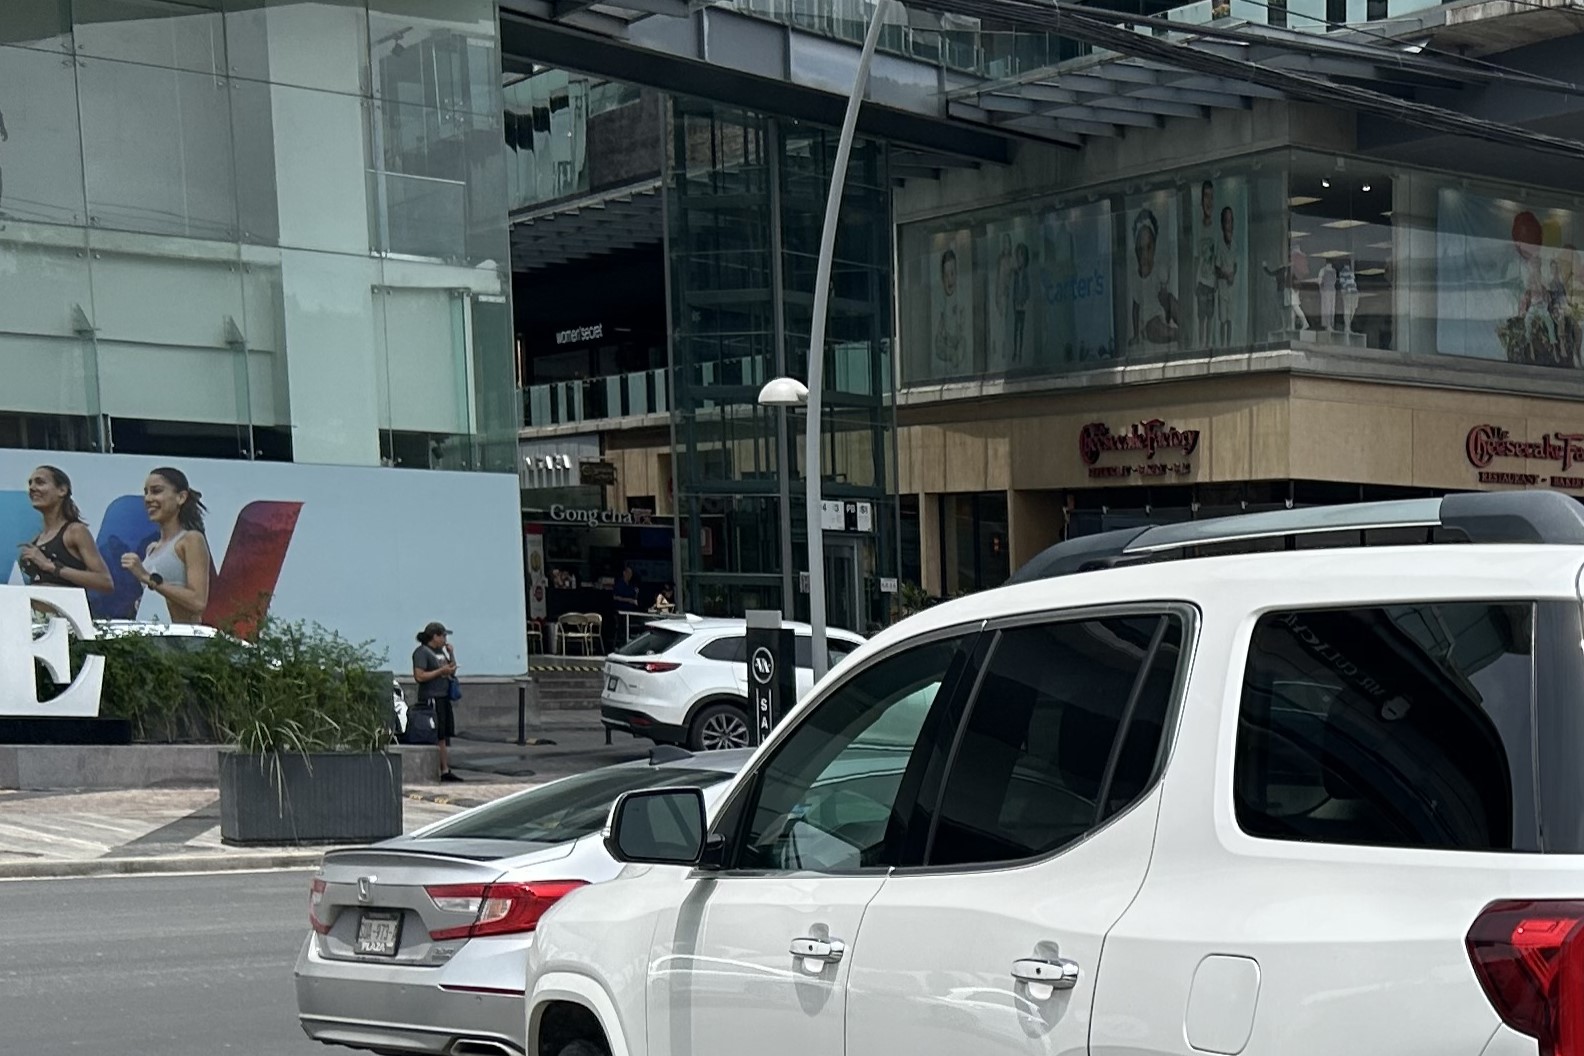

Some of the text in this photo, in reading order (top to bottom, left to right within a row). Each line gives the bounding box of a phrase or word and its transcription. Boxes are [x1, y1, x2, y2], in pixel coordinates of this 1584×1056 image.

[1466, 424, 1565, 468] Cheesecake
[550, 504, 599, 528] Gong
[601, 508, 632, 524] cha
